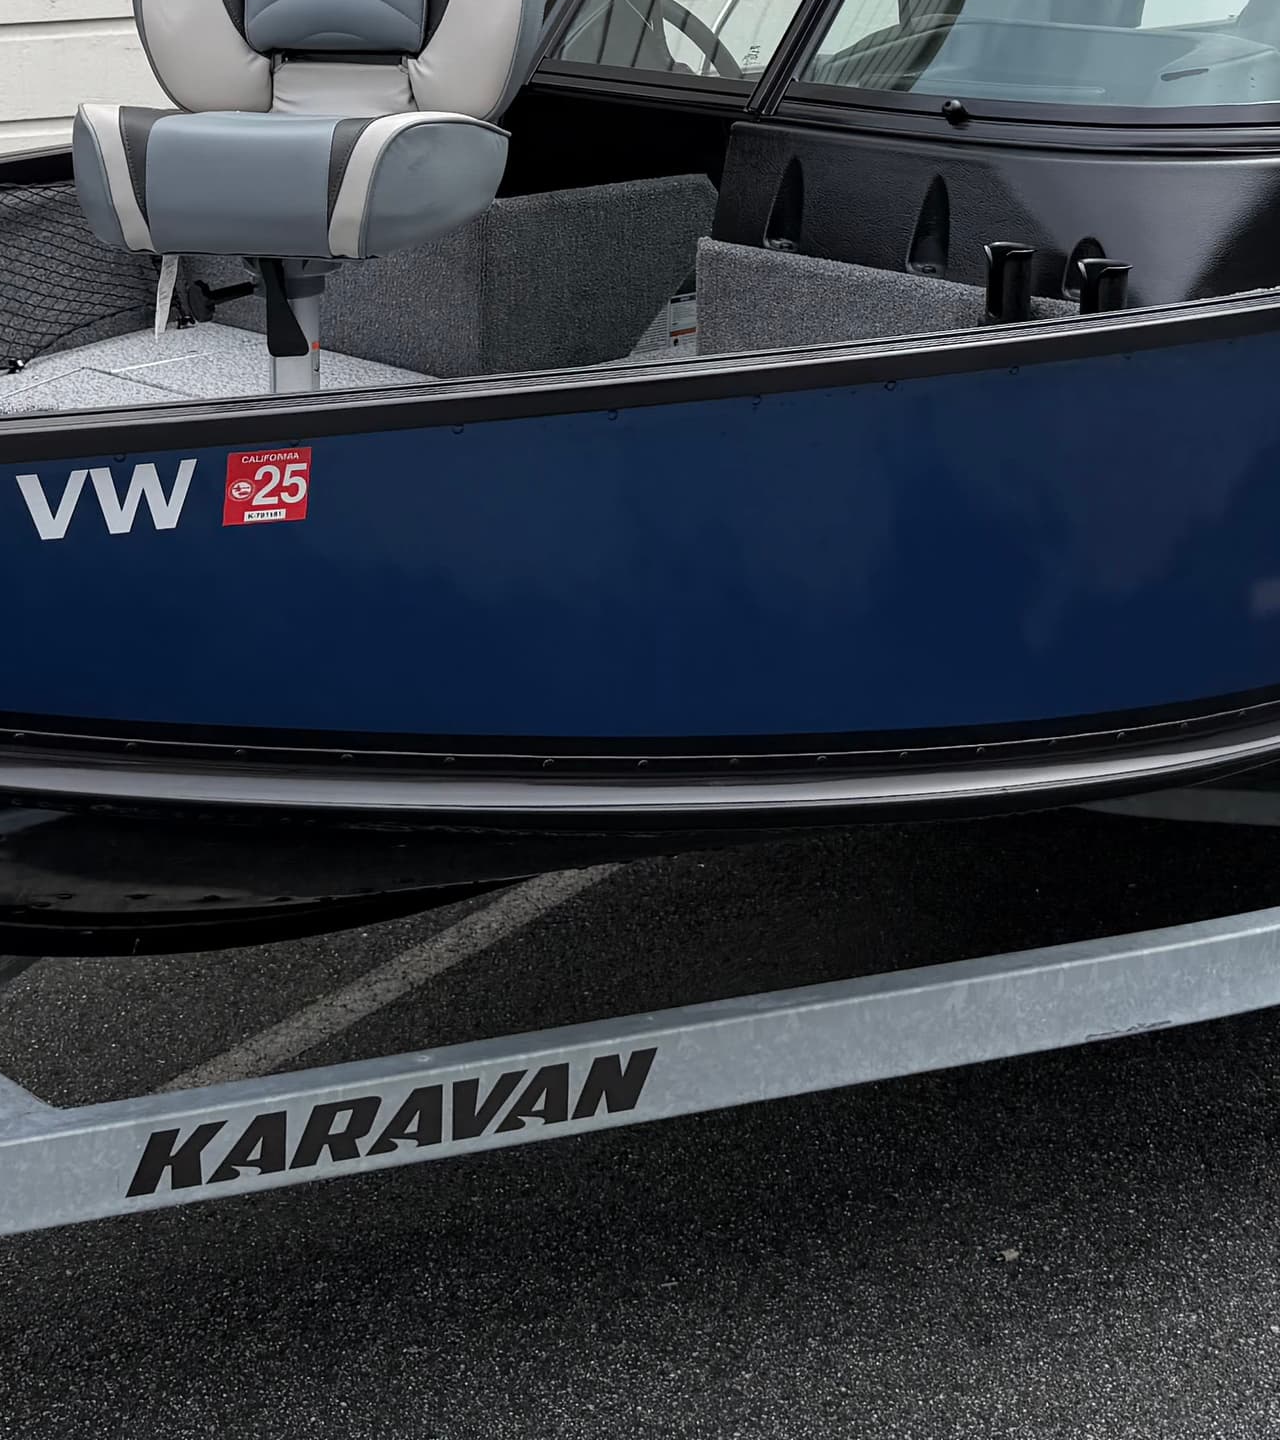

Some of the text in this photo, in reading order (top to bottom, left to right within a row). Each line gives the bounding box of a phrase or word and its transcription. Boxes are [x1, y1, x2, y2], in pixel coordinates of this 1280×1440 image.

[16, 458, 197, 541] VW
[251, 462, 308, 506] 25
[125, 1047, 658, 1198] KARAVAN
